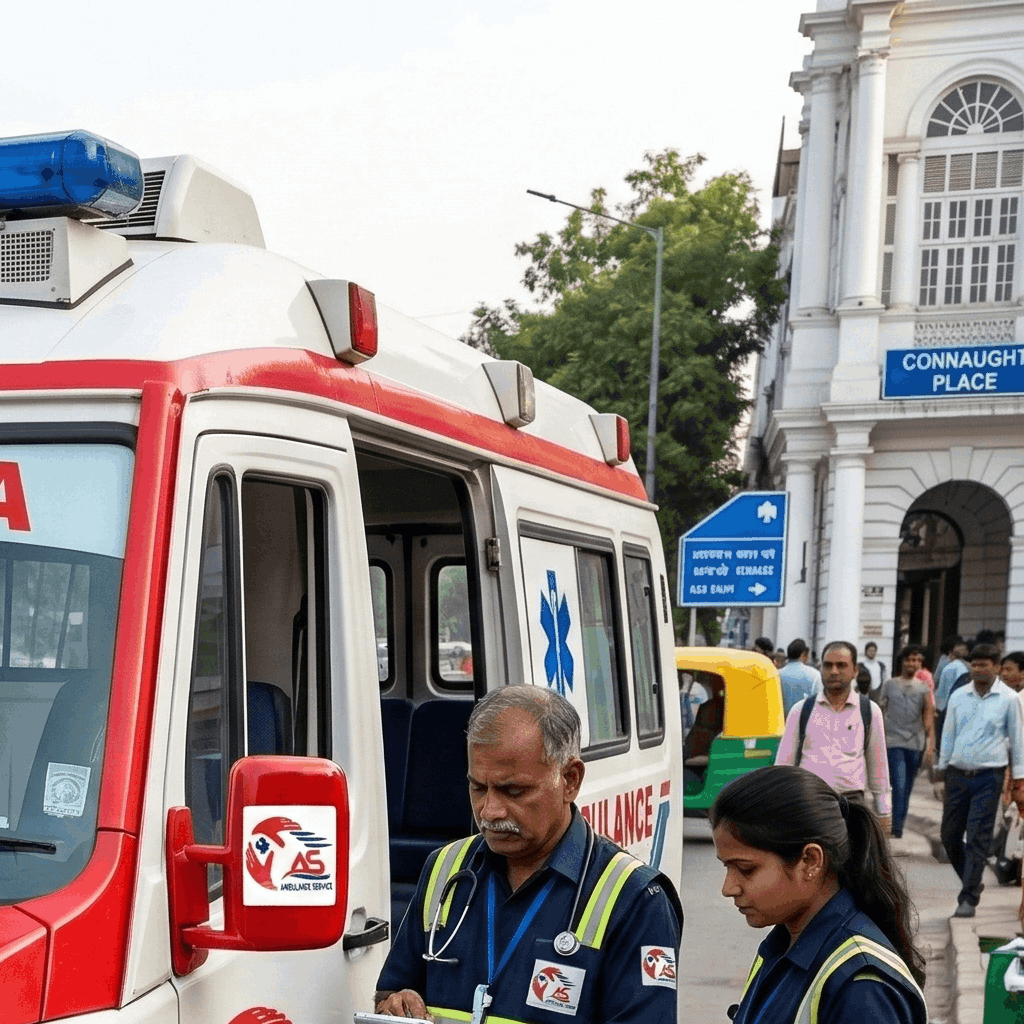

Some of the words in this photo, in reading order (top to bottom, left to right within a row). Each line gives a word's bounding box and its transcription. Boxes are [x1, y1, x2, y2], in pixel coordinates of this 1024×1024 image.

[902, 349, 1024, 371] CONNAUGHT
[932, 372, 998, 392] PLACE
[289, 849, 325, 876] AS
